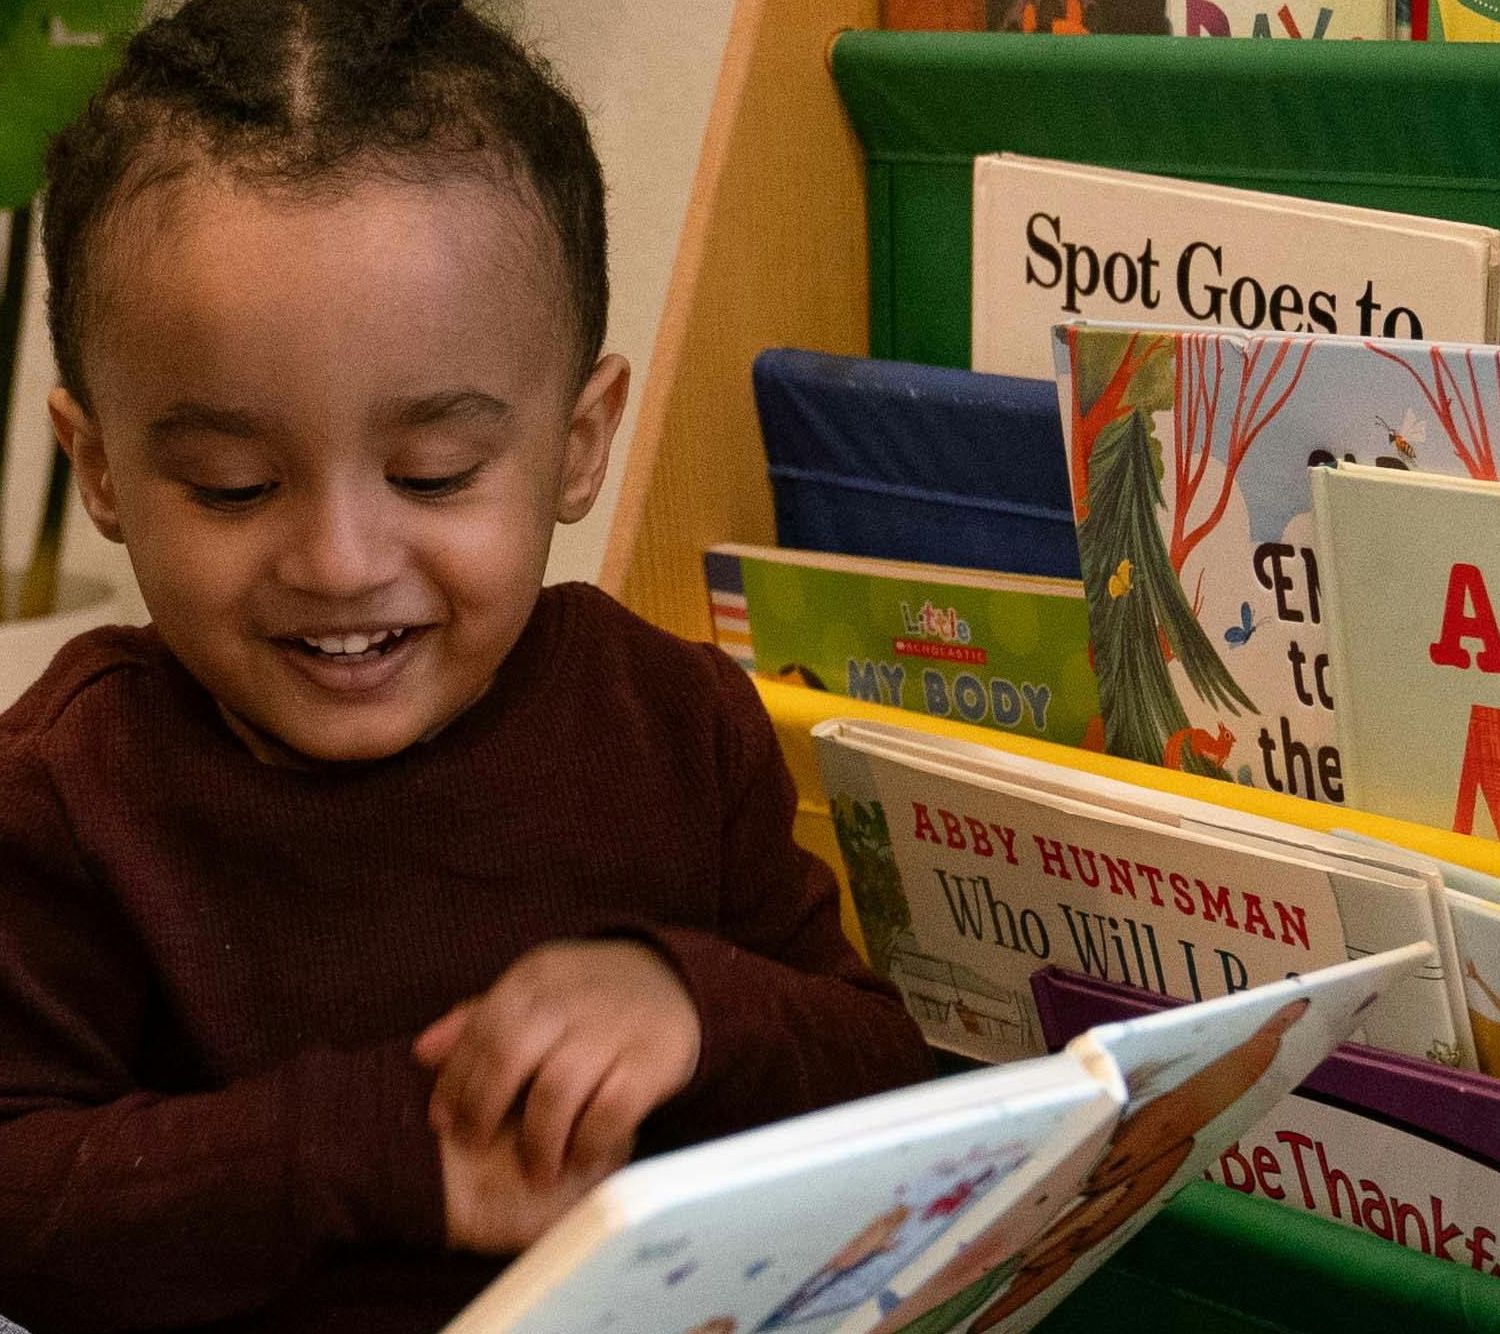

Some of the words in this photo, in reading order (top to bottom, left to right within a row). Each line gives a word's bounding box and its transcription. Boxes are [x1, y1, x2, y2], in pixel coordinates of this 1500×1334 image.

[1026, 212, 1161, 314] Spot
[1176, 241, 1337, 334] Goes
[901, 601, 970, 644] Little
[904, 641, 984, 663] SCHOLASTIC
[847, 659, 904, 707] MY
[923, 668, 1050, 732] BODY
[912, 802, 1019, 865] ABBY
[1034, 835, 1310, 950] HUNTSMAN
[934, 869, 1050, 958] Who
[1058, 904, 1166, 995] Will
